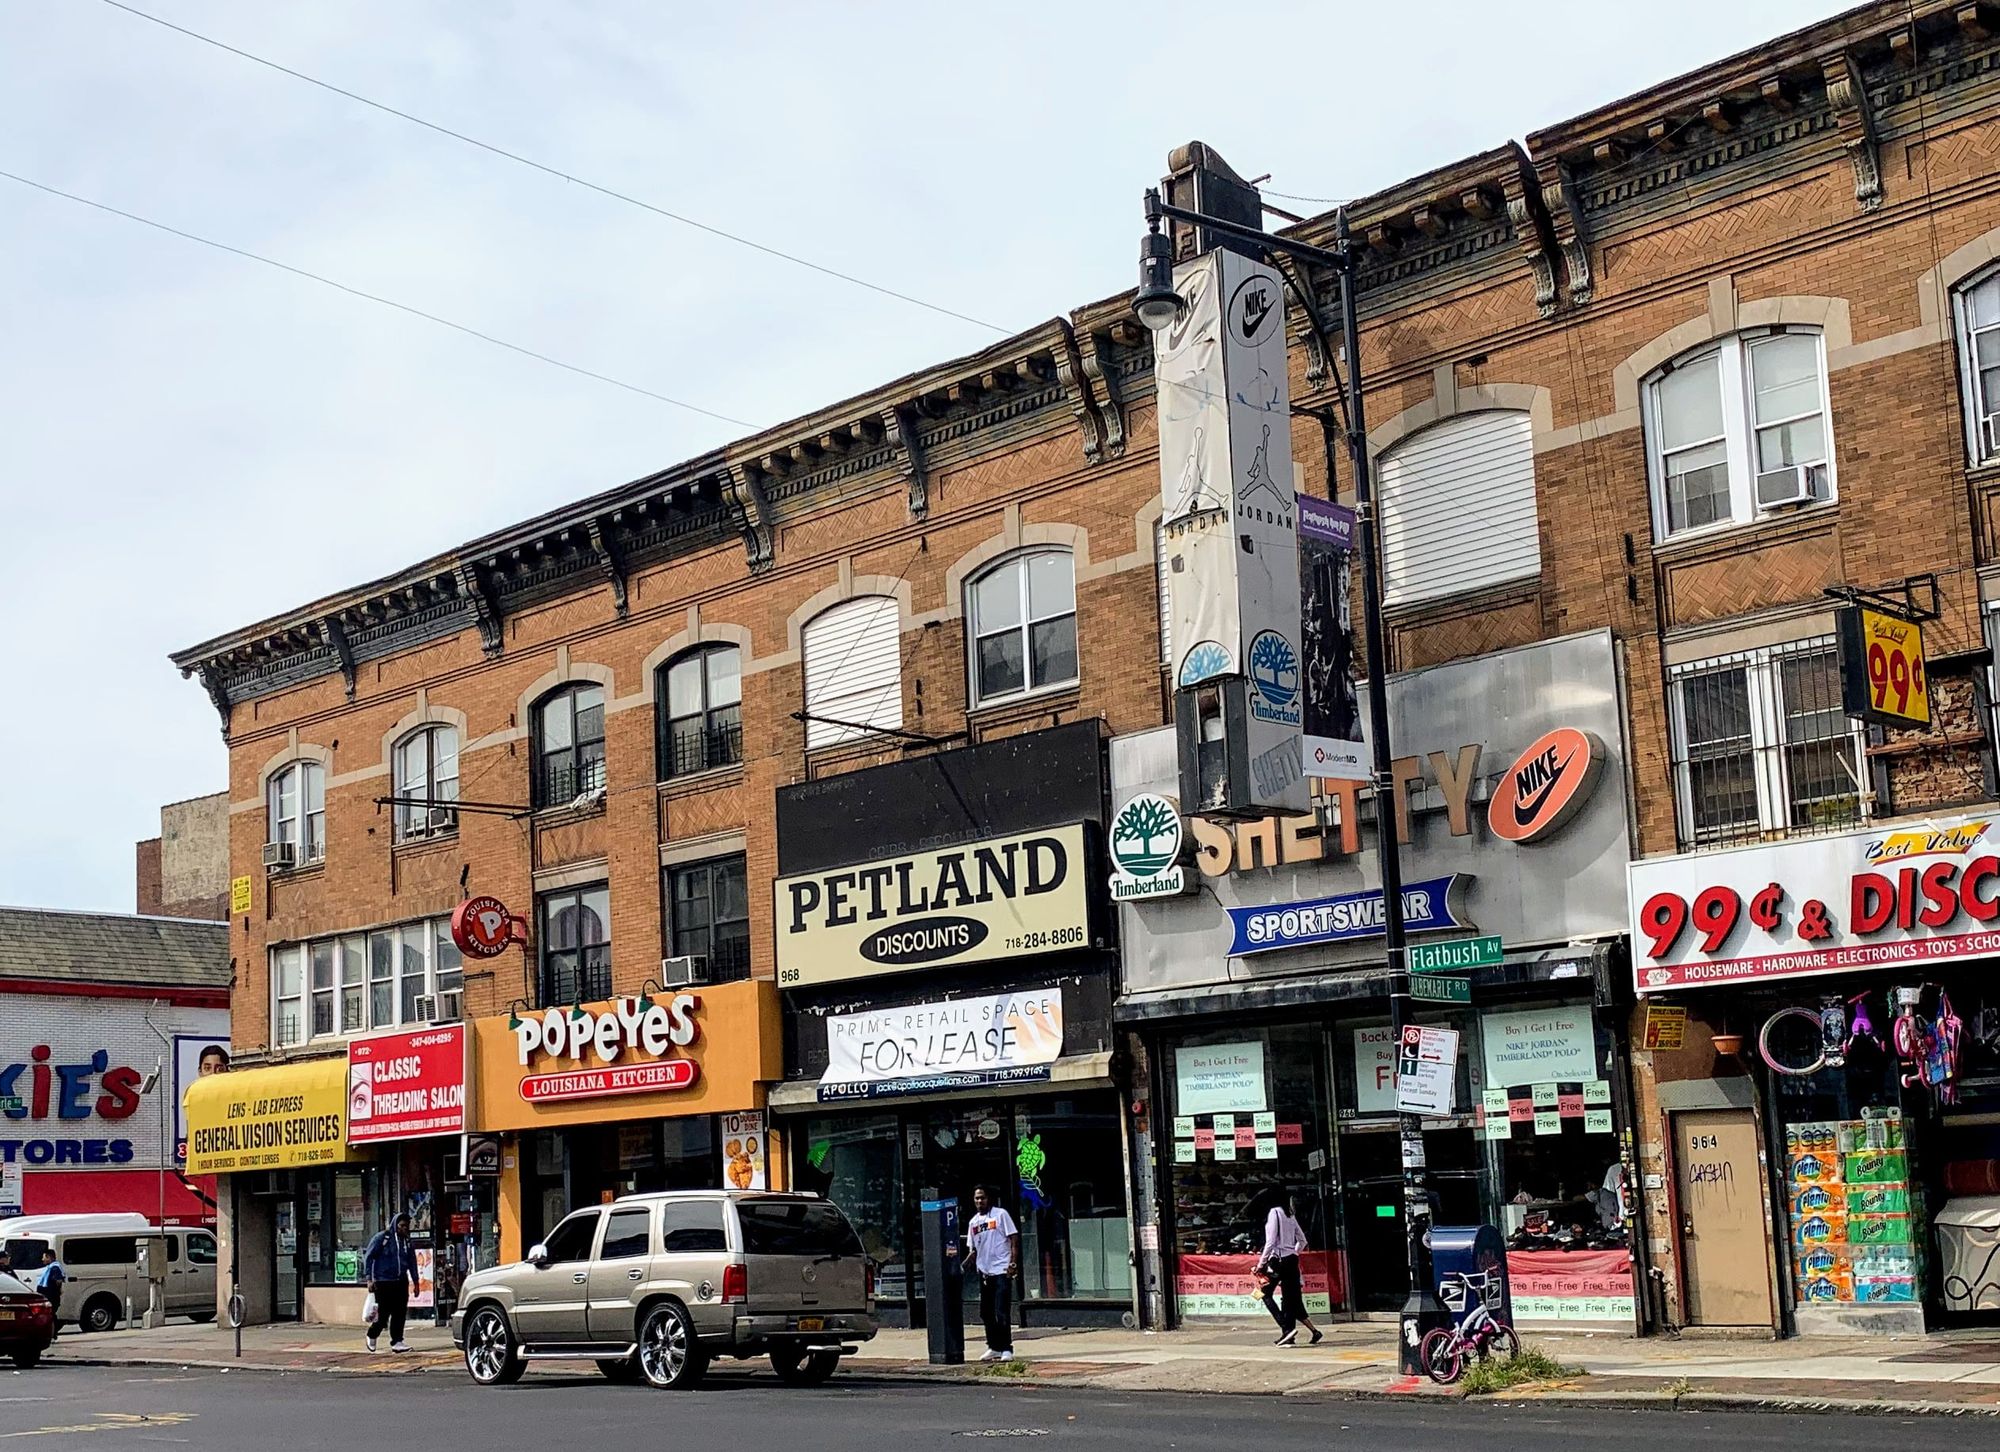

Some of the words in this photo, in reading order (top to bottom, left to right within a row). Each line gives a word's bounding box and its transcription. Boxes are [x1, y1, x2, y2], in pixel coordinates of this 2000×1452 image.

[1244, 289, 1267, 317] NIKE
[1238, 504, 1292, 529] JORDAN
[1169, 510, 1229, 539] JORDAN
[1254, 700, 1300, 723] Timberland
[1515, 744, 1562, 802] NIKE
[1865, 840, 1911, 859] Best
[1922, 830, 1982, 850] Value
[788, 837, 1067, 934] PETLAND
[1113, 872, 1179, 897] Timberland
[1798, 900, 1832, 942] &
[1851, 856, 2000, 934] DISC
[467, 901, 509, 924] LOUISIANA
[1248, 892, 1432, 942] SPORTSWER
[468, 934, 508, 953] KITCHEN
[876, 924, 969, 957] DISCOUNTS
[1005, 927, 1083, 950] 718-284-8806
[1412, 942, 1480, 969] Flatbush
[1685, 961, 1754, 979] HOUSEWARE
[1762, 954, 1827, 971] HARDWARE
[1837, 944, 1917, 964] ELECTRONICS
[1926, 940, 1956, 954] TOYS
[781, 969, 799, 982] 968
[1411, 977, 1452, 998] ALBEMARLE
[1455, 982, 1467, 991] RD
[837, 1019, 890, 1038] PRIME
[904, 1009, 968, 1029] RETAIL
[982, 999, 1049, 1020] SPACE
[1505, 1025, 1520, 1035] Buy
[1531, 1024, 1546, 1032] Get
[1556, 1021, 1574, 1030] Free
[1361, 1032, 1388, 1043] Back
[860, 1037, 918, 1074] FOR
[925, 1027, 1017, 1067] LEASE
[1376, 1051, 1393, 1060] Buy
[374, 1056, 421, 1083] CLASSIC
[1193, 1059, 1206, 1067] Buy
[1406, 1061, 1412, 1074] 1
[532, 1074, 605, 1096] LOUISIANA
[611, 1066, 676, 1087] KITCHEN
[822, 1082, 868, 1096] APOLLO
[1535, 1091, 1554, 1099] Free
[1586, 1089, 1606, 1097] Free
[373, 1089, 427, 1115] THREADING
[431, 1084, 465, 1110] SALON
[228, 1102, 246, 1118] LENS
[253, 1099, 268, 1116] LAB
[270, 1096, 304, 1114] EXPRESS
[1339, 1109, 1355, 1118] 966
[1511, 1106, 1530, 1114] Free
[1588, 1117, 1608, 1126] Free
[195, 1124, 240, 1154] GENERAL
[242, 1120, 282, 1149] VISION
[285, 1114, 339, 1145] SERVICES
[1692, 1136, 1717, 1149] 964
[0, 1139, 133, 1163] TORES
[240, 1156, 260, 1167] CONTACT
[262, 1154, 279, 1165] LENSES
[1856, 1158, 1883, 1177] Bounty
[1861, 1192, 1885, 1211] Bounty
[1862, 1222, 1886, 1240] Bounty
[1179, 1281, 1194, 1289] Free
[1198, 1281, 1214, 1289] Free
[1218, 1280, 1234, 1289] Free
[1238, 1281, 1255, 1289] Free
[1305, 1280, 1325, 1289] Free
[1532, 1282, 1552, 1290] Free
[1558, 1282, 1577, 1290] Free
[1609, 1282, 1630, 1290] Free
[1867, 1285, 1890, 1302] Bounty
[1180, 1300, 1196, 1309] Free
[1200, 1300, 1215, 1309] Free
[1220, 1300, 1236, 1308] Free
[1240, 1300, 1256, 1308] Free
[1306, 1299, 1326, 1308] Free
[1534, 1303, 1554, 1311] Free
[1560, 1303, 1580, 1312] Free
[1585, 1303, 1606, 1312] Free
[1611, 1304, 1632, 1312] Free
